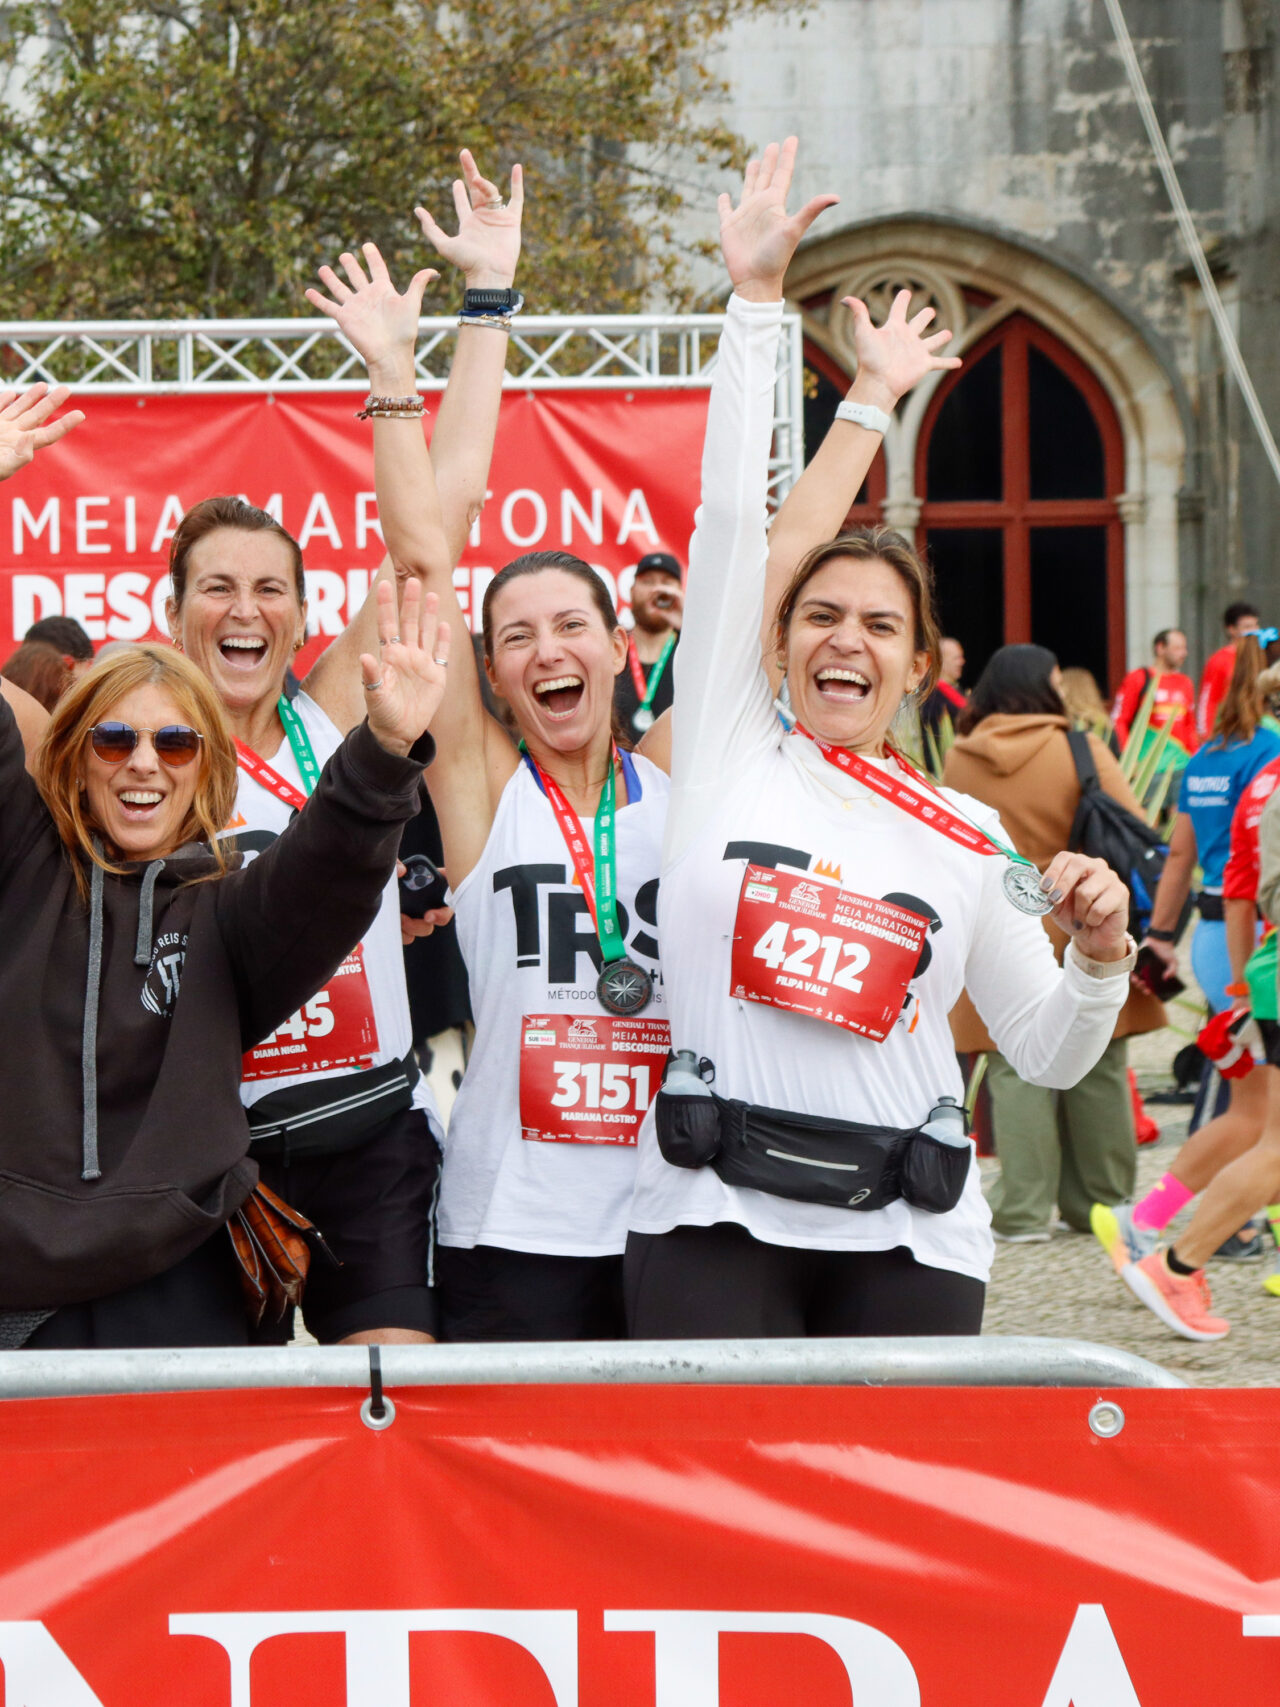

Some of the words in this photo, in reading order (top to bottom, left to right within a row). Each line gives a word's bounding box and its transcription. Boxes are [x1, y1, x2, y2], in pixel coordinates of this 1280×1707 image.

[835, 903, 862, 919] MEIA
[865, 912, 921, 941] MARATONA
[157, 932, 180, 948] REIS
[831, 914, 920, 952] DESCOBRIMENTOS
[753, 920, 871, 994] 4212
[775, 975, 804, 991] FILIPA
[804, 980, 829, 997] VALE
[612, 1020, 646, 1030] GENERALI
[612, 1031, 638, 1041] MEIA
[641, 1033, 670, 1043] MARA
[253, 1047, 281, 1060] DIANA
[280, 1043, 308, 1056] NIGRA
[550, 1060, 650, 1111] 3151
[561, 1111, 602, 1122] MARIANA
[603, 1114, 638, 1124] CASTRO
